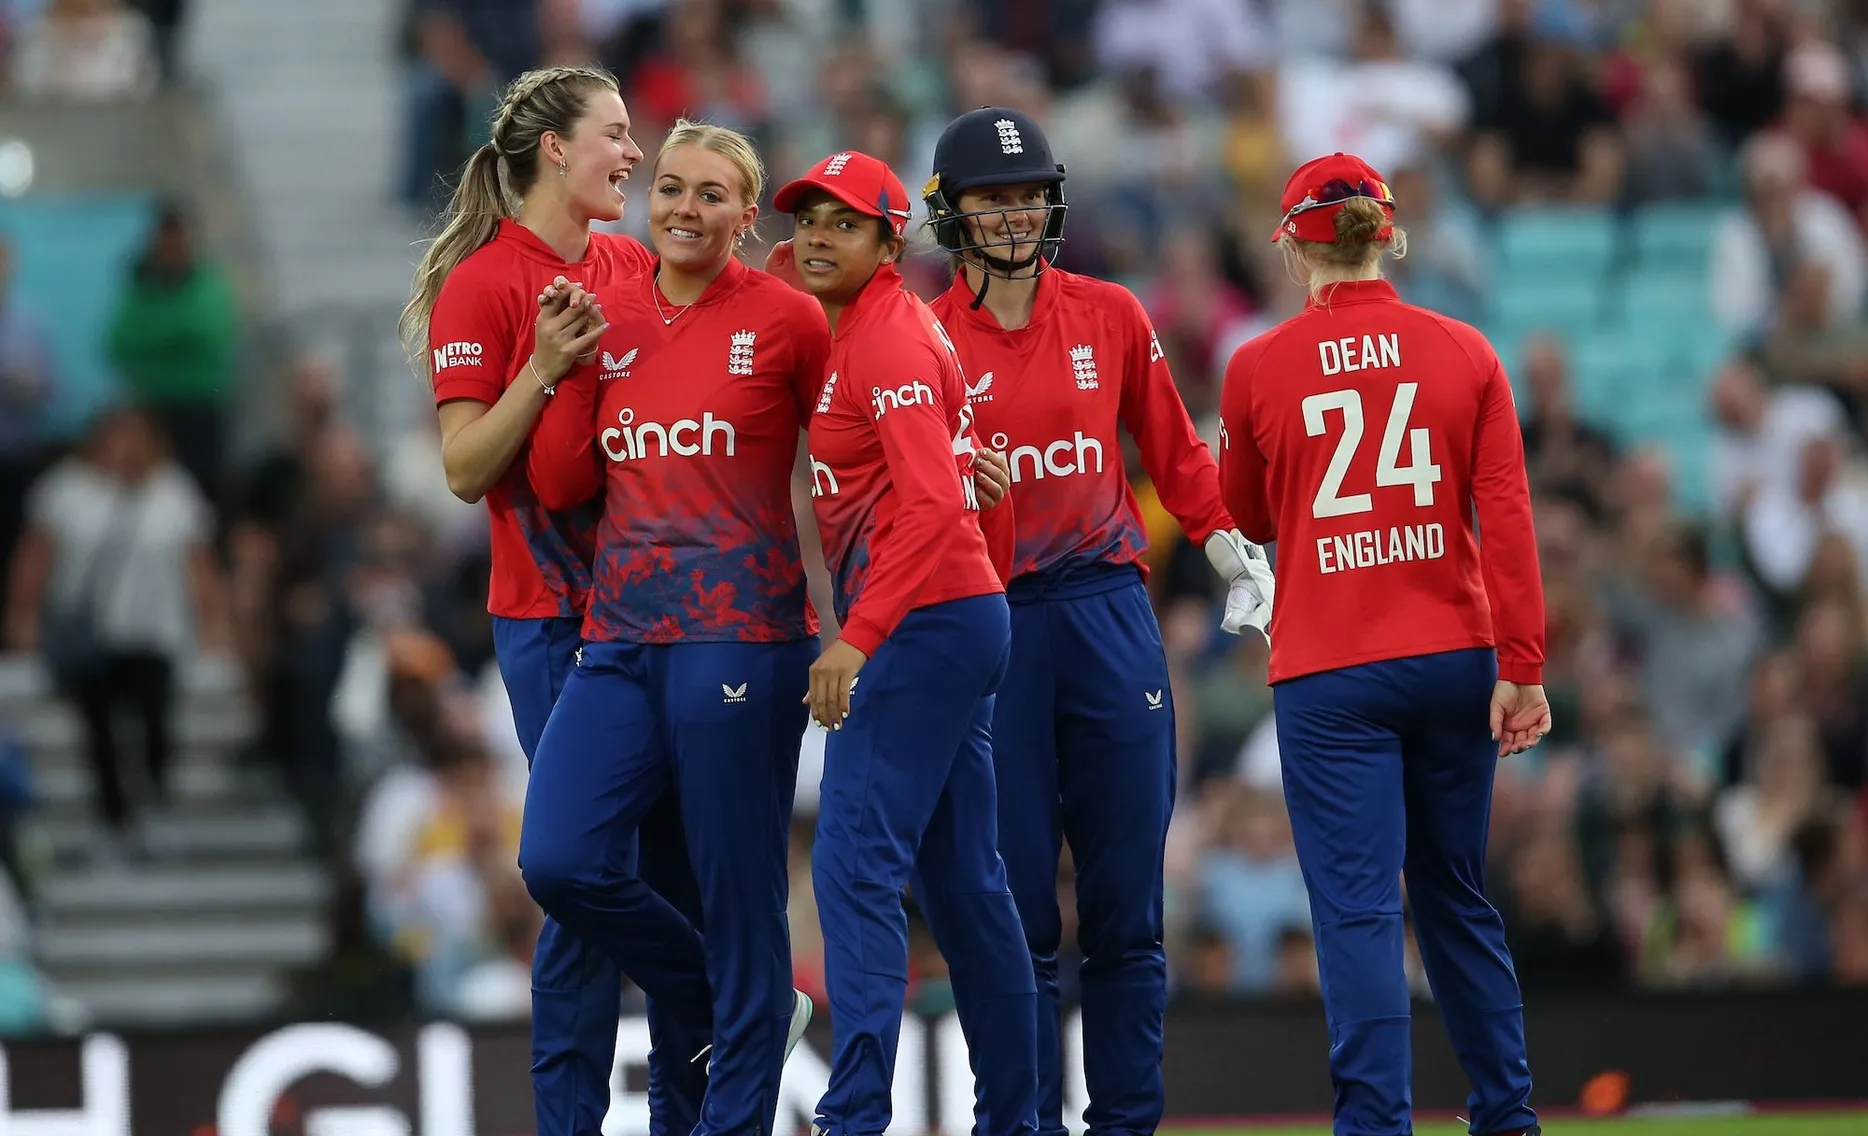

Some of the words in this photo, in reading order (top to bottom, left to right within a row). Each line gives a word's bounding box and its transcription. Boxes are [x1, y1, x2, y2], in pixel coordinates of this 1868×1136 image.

[433, 341, 483, 374] METRO
[449, 356, 483, 367] BANK
[599, 371, 631, 380] CASTORE
[1318, 334, 1401, 376] DEAN
[966, 394, 994, 404] STORE
[601, 407, 735, 462] cinch
[1301, 382, 1442, 518] 24
[991, 431, 1103, 483] inch
[1316, 523, 1445, 574] ENGLAND
